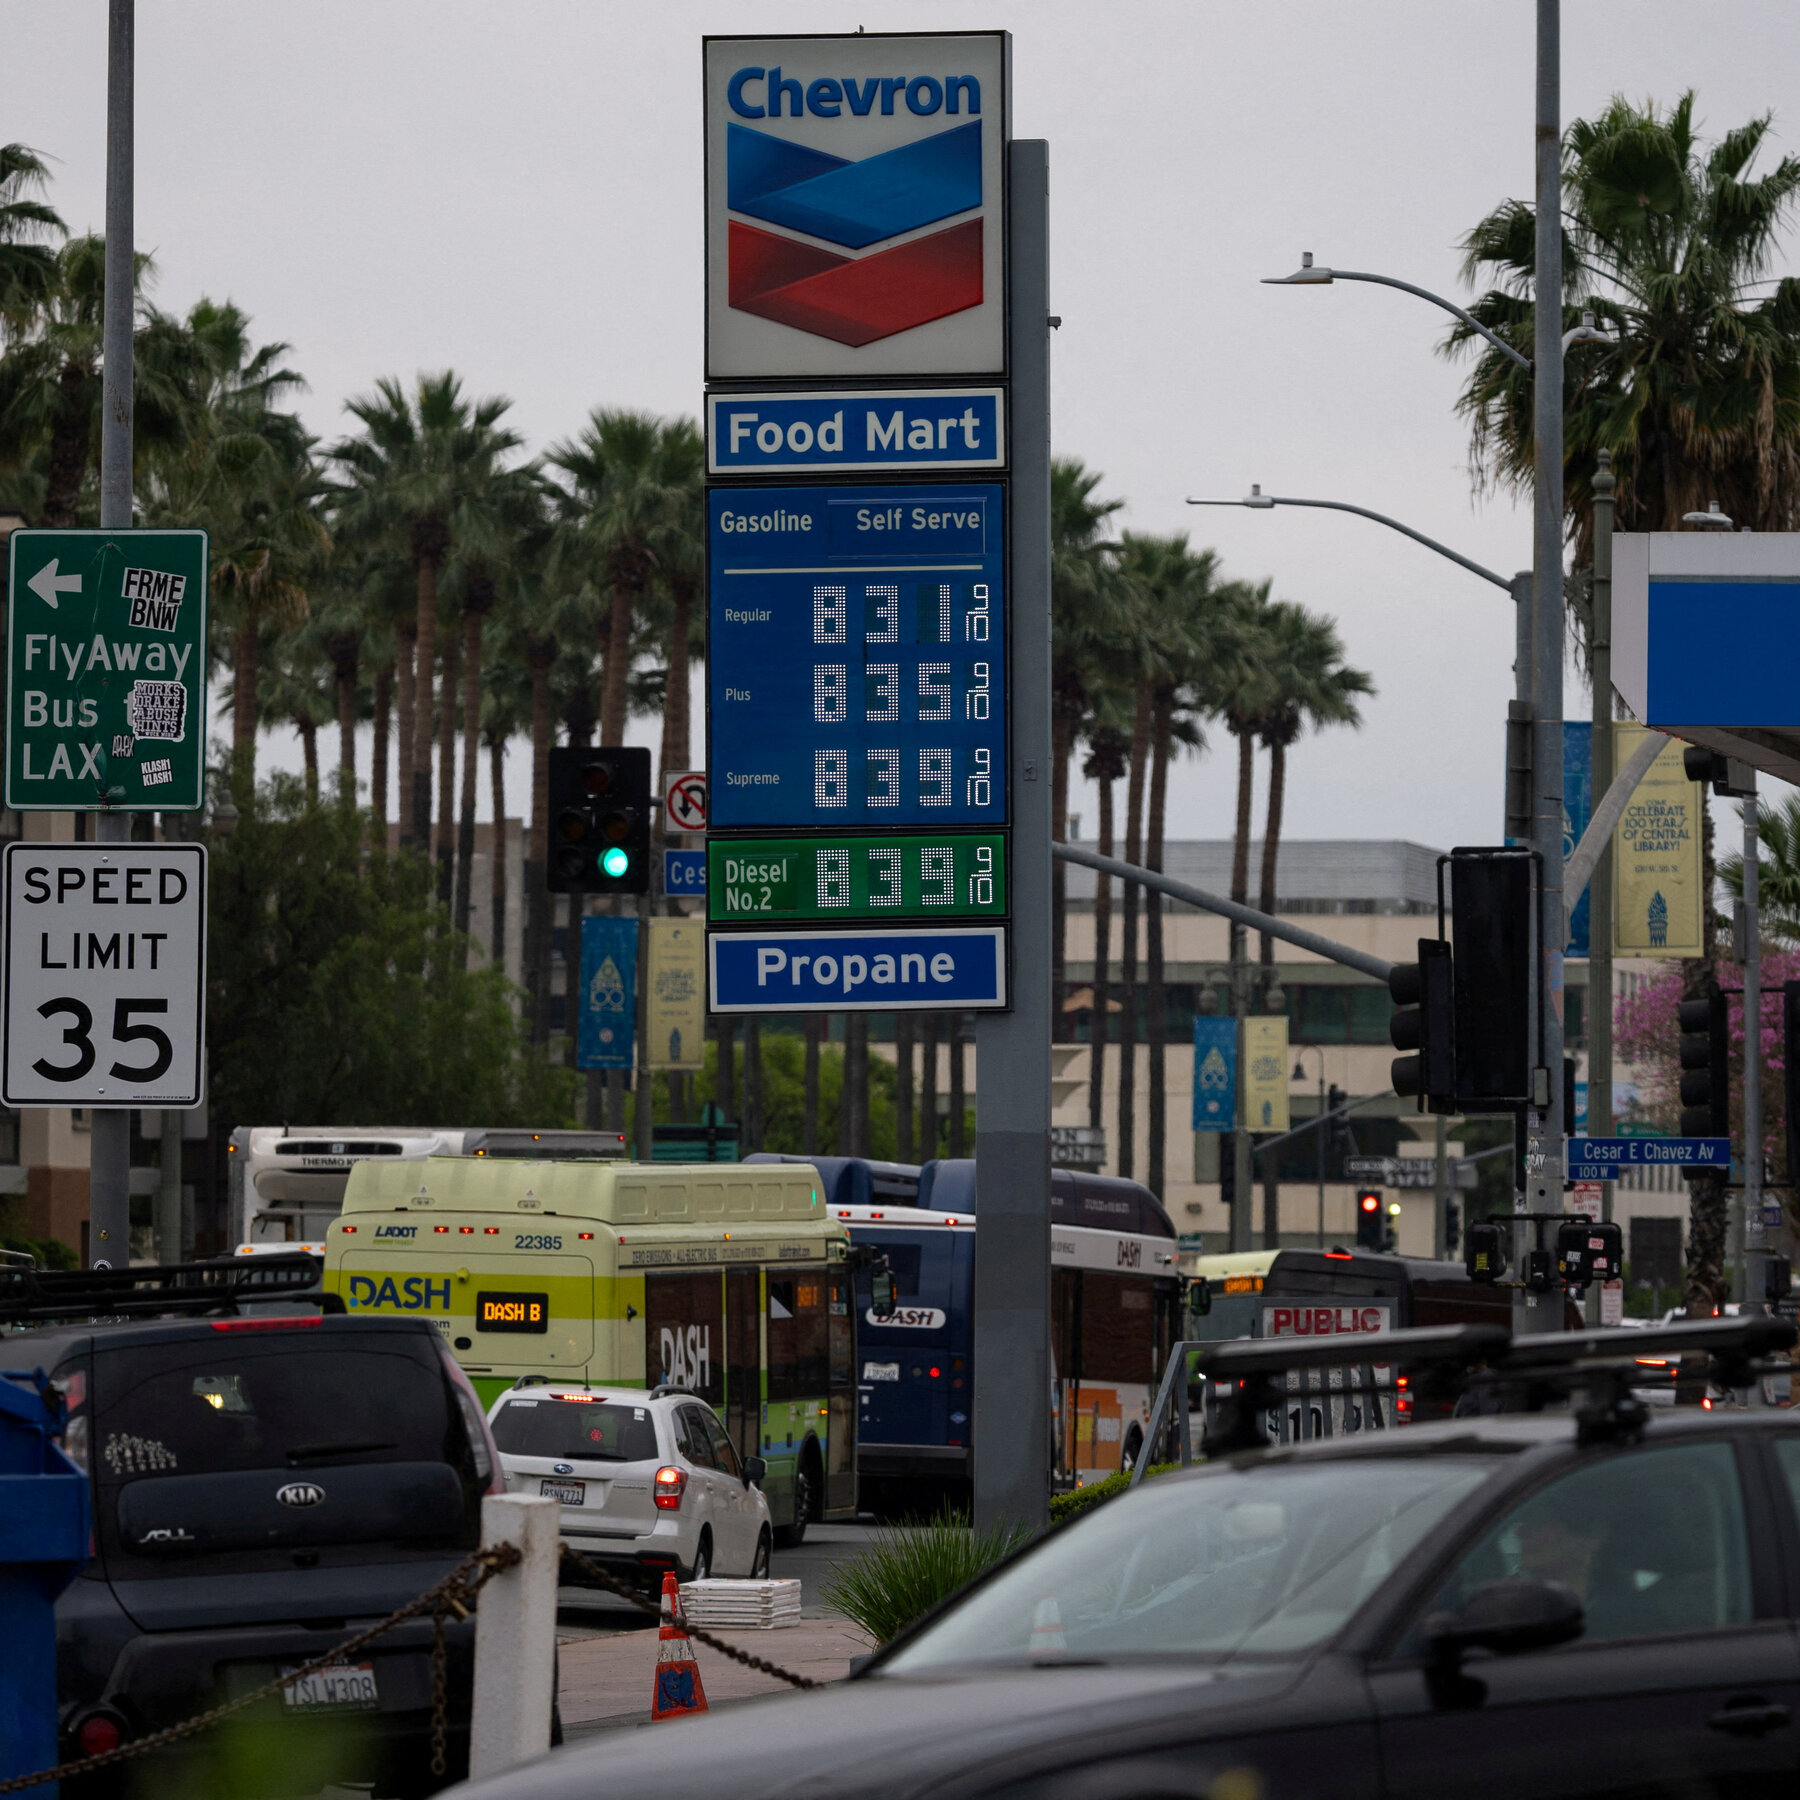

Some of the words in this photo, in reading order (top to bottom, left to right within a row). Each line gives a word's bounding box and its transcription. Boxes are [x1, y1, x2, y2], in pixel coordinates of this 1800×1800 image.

[727, 66, 982, 118] Chevron
[729, 410, 844, 453] Food
[866, 407, 980, 452] Mart
[720, 510, 813, 533] Gasoline
[856, 508, 902, 530] Self
[911, 508, 980, 530] Serve
[124, 568, 184, 603] FRME
[130, 597, 178, 631] BNW
[725, 608, 772, 625] Regular
[25, 634, 193, 681] FlyAway
[136, 682, 181, 697] MORKS
[725, 688, 751, 701] Plus
[24, 690, 98, 728] Bus
[123, 691, 135, 727] t
[136, 696, 180, 709] DRAKE
[136, 708, 178, 721] ABUSE
[136, 720, 178, 733] HINTS
[23, 743, 103, 780] LAX
[141, 758, 171, 774] KLASH1
[142, 770, 173, 787] KLASH1
[726, 771, 780, 786] Supreme
[1627, 805, 1686, 817] CELEBRATE
[1625, 817, 1646, 829] 100
[1649, 817, 1689, 829] YEARS
[1623, 829, 1639, 840] OF
[1641, 829, 1691, 840] CENTRAL
[1633, 841, 1681, 852] LIBRARY!
[725, 858, 788, 884] Diesel
[23, 866, 188, 905] SPEED
[725, 886, 773, 911] No.2
[41, 932, 168, 970] LIMIT
[757, 947, 956, 994] Propane
[32, 996, 173, 1083] 35
[1584, 1142, 1621, 1160] Cesar
[1629, 1142, 1638, 1160] E
[1644, 1142, 1692, 1160] Chavez
[1698, 1142, 1714, 1160] Av
[302, 1157, 345, 1166] THERMO
[1579, 1166, 1598, 1178] 100
[1599, 1166, 1609, 1178] W
[375, 1226, 418, 1237] LADOT
[515, 1235, 562, 1250] 22385
[1117, 1240, 1142, 1268] DASH
[348, 1276, 450, 1309] DASH
[484, 1302, 526, 1322] DASH
[530, 1302, 541, 1322] B
[876, 1311, 935, 1326] DASH
[1273, 1307, 1382, 1335] PUBLIC
[661, 1324, 710, 1388] DASH
[285, 1488, 319, 1503] KIA
[140, 1528, 195, 1543] SOUL
